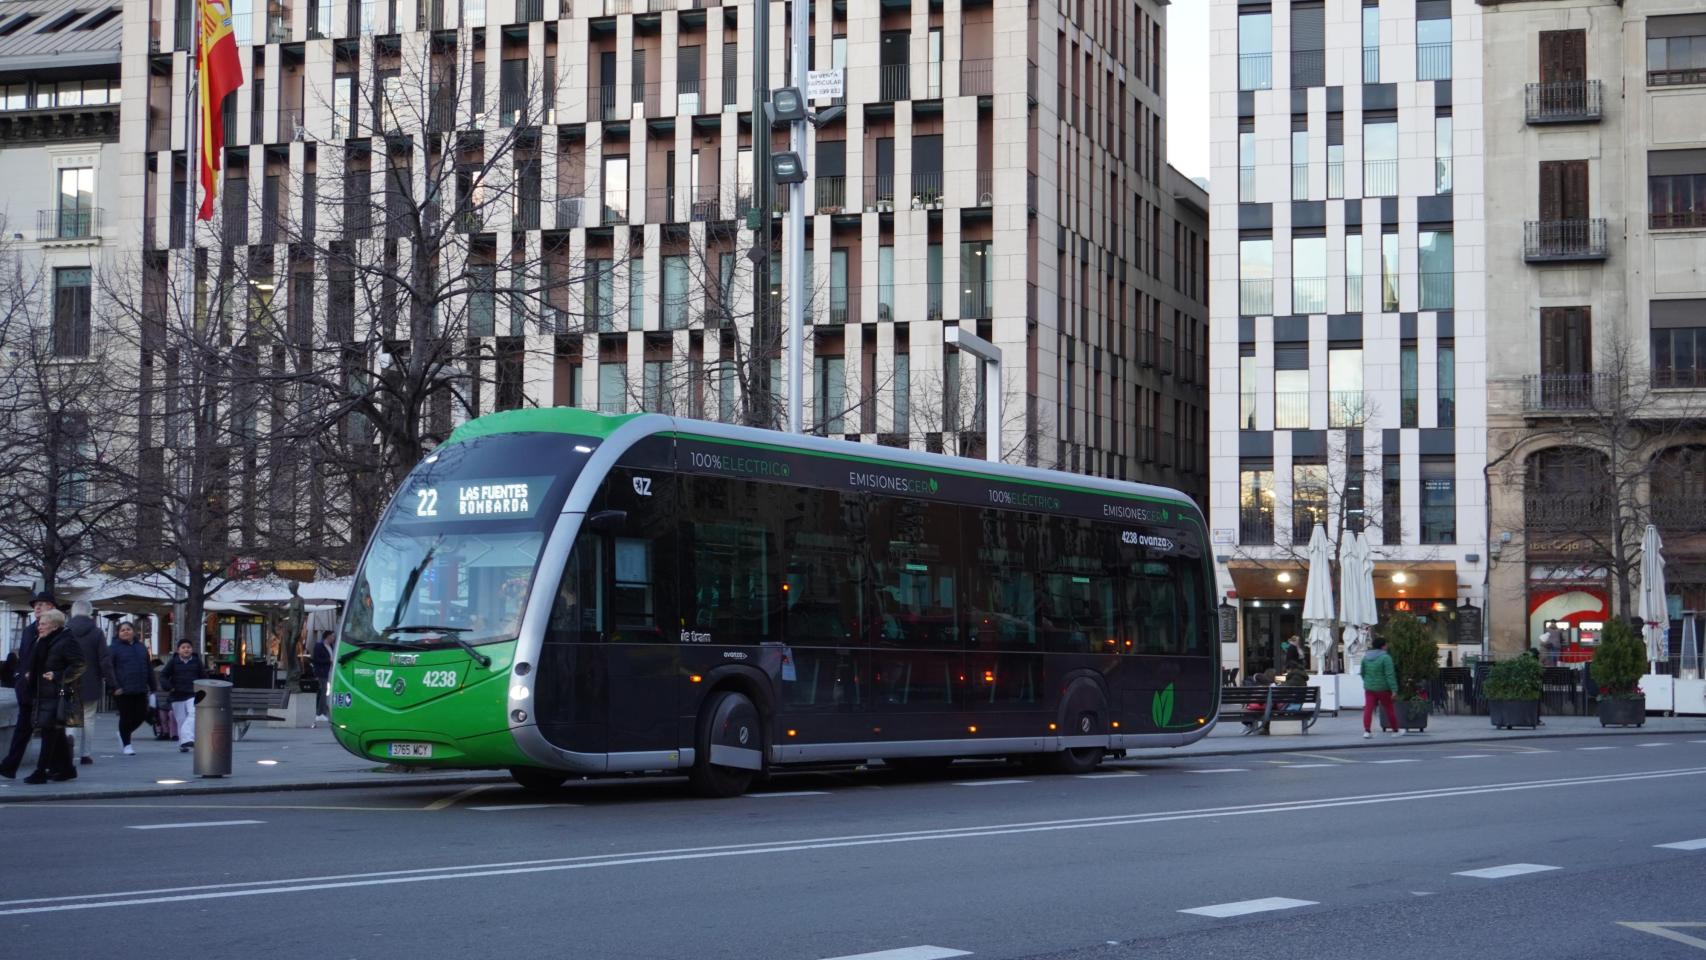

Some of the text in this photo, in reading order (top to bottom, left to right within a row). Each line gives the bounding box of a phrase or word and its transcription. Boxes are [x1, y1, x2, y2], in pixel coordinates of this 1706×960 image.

[460, 484, 528, 500] LAS FUENTES
[417, 488, 438, 516] 22
[459, 499, 528, 514] BOMBARDA
[1122, 531, 1167, 547] 4238 avanza
[422, 671, 456, 688] 4238
[393, 744, 411, 755] 3765
